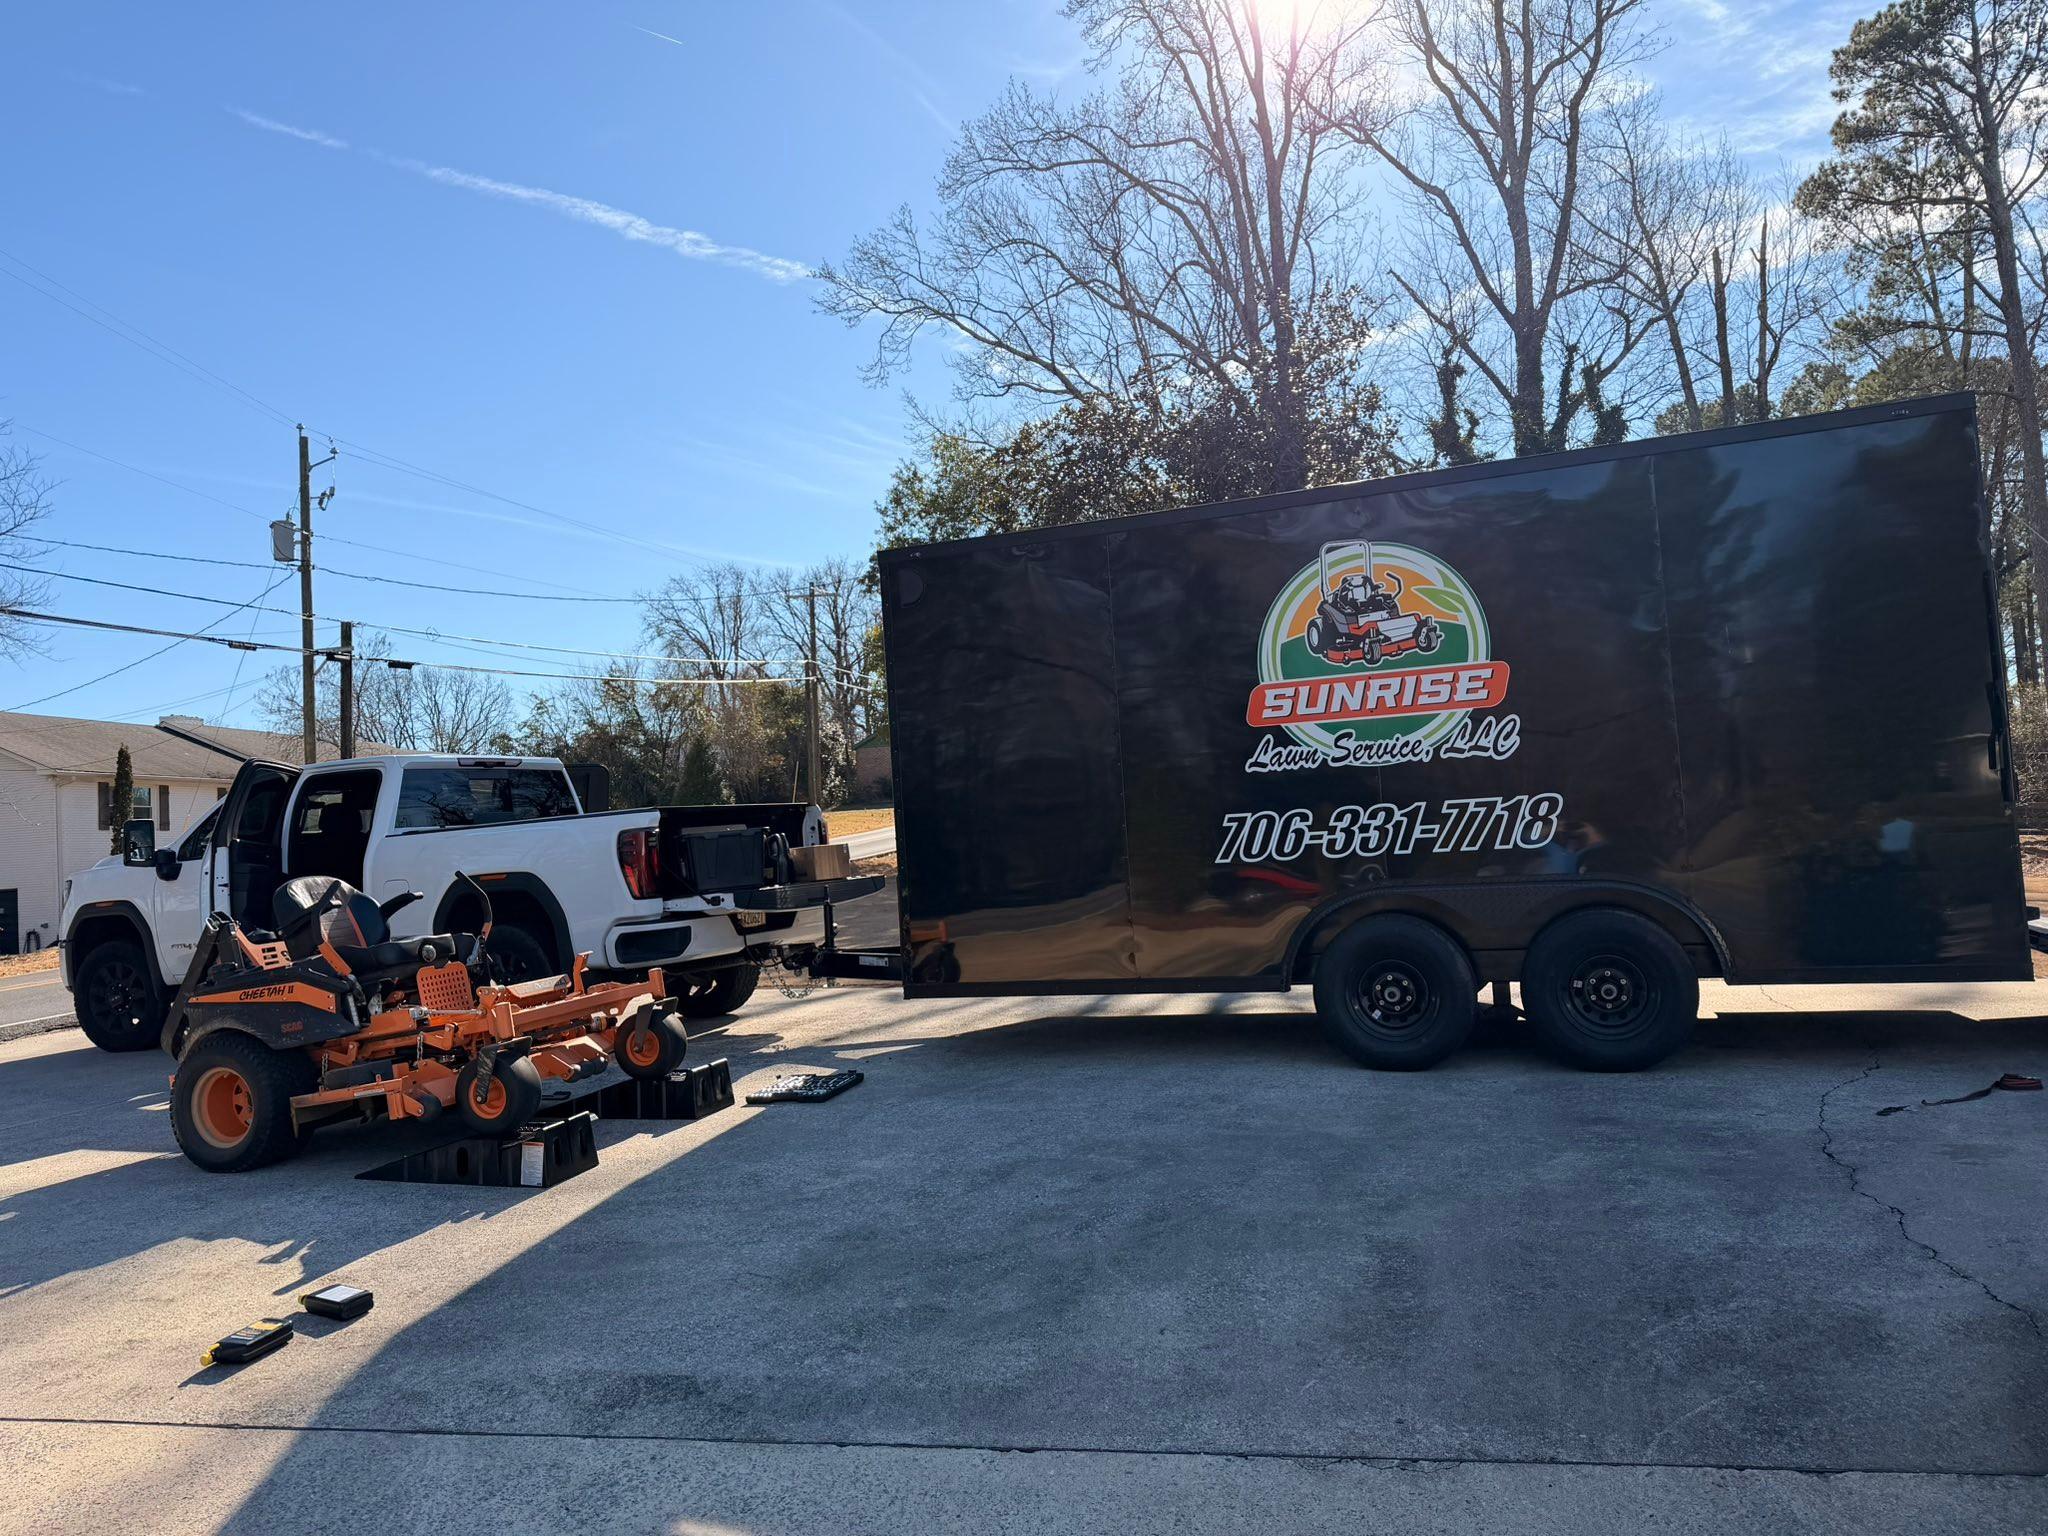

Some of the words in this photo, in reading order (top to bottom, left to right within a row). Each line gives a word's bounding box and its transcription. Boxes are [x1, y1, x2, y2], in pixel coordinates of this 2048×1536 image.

[1262, 667, 1494, 720] SUNRISE
[1246, 733, 1323, 772] Lawn
[1327, 729, 1433, 767] Service,
[1440, 713, 1521, 760] LLC
[1213, 792, 1564, 864] 706-331-7718
[239, 985, 285, 1000] CHEETAH
